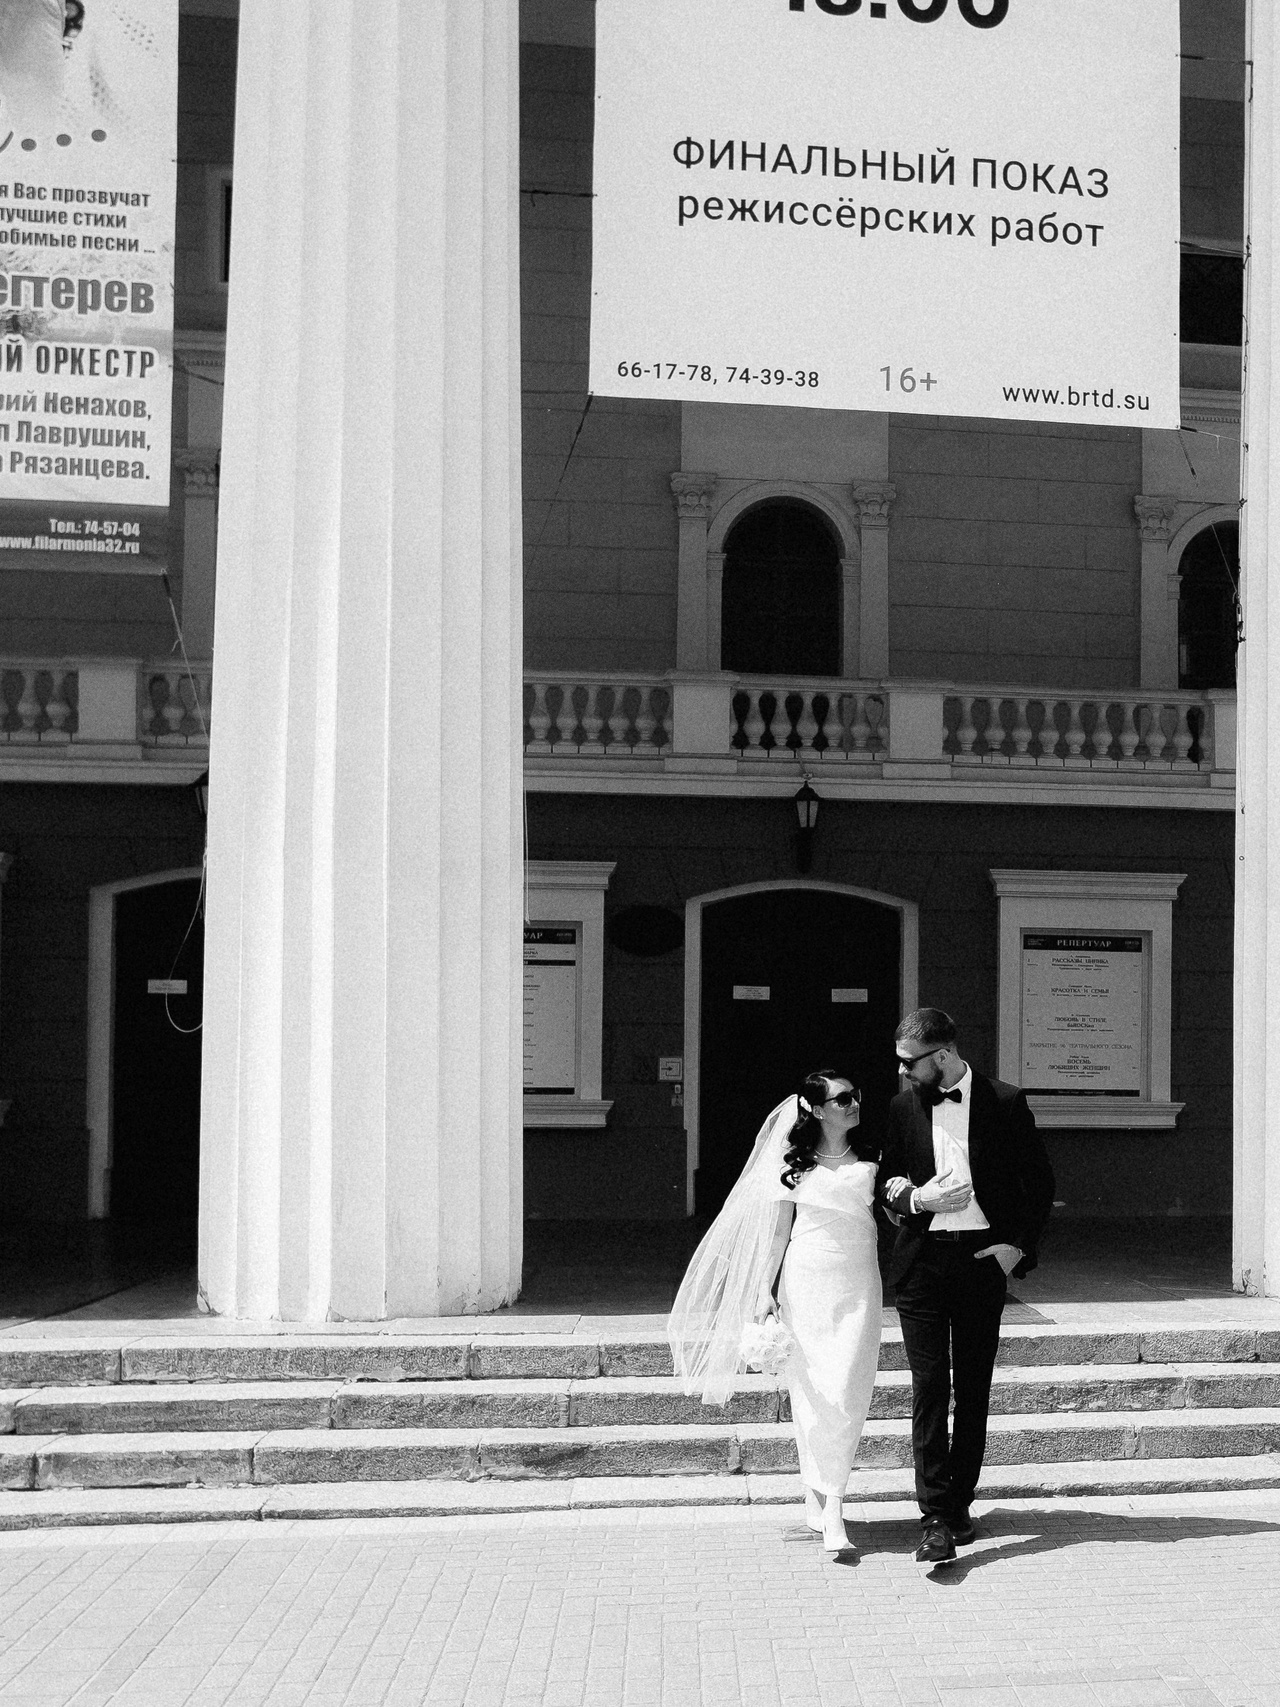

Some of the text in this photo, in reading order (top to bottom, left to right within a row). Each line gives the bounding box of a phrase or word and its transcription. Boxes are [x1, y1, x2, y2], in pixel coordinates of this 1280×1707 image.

[672, 136, 1110, 199] ФИНАЛЬНЫЙ ПОКАЗ
[14, 182, 47, 200] Вас
[52, 187, 151, 207] прозвучат
[73, 212, 127, 228] стихи
[677, 194, 1105, 247] режиссёрских работ
[82, 234, 140, 252] песни
[36, 345, 155, 378] ОРКЕСТР
[616, 360, 820, 388] 66-17-78, 74-39-38
[880, 365, 938, 393] 16+
[44, 391, 152, 421] Ненахов,
[1002, 383, 1151, 411] www.brtd.su
[15, 420, 151, 452] Лаврушин,
[10, 451, 150, 480] Рязанцева.
[49, 518, 140, 537] Тел.: 74-57-04
[0, 535, 140, 554] www.filarmonia32.ru
[1057, 938, 1112, 948] РЕПЕРТУАР
